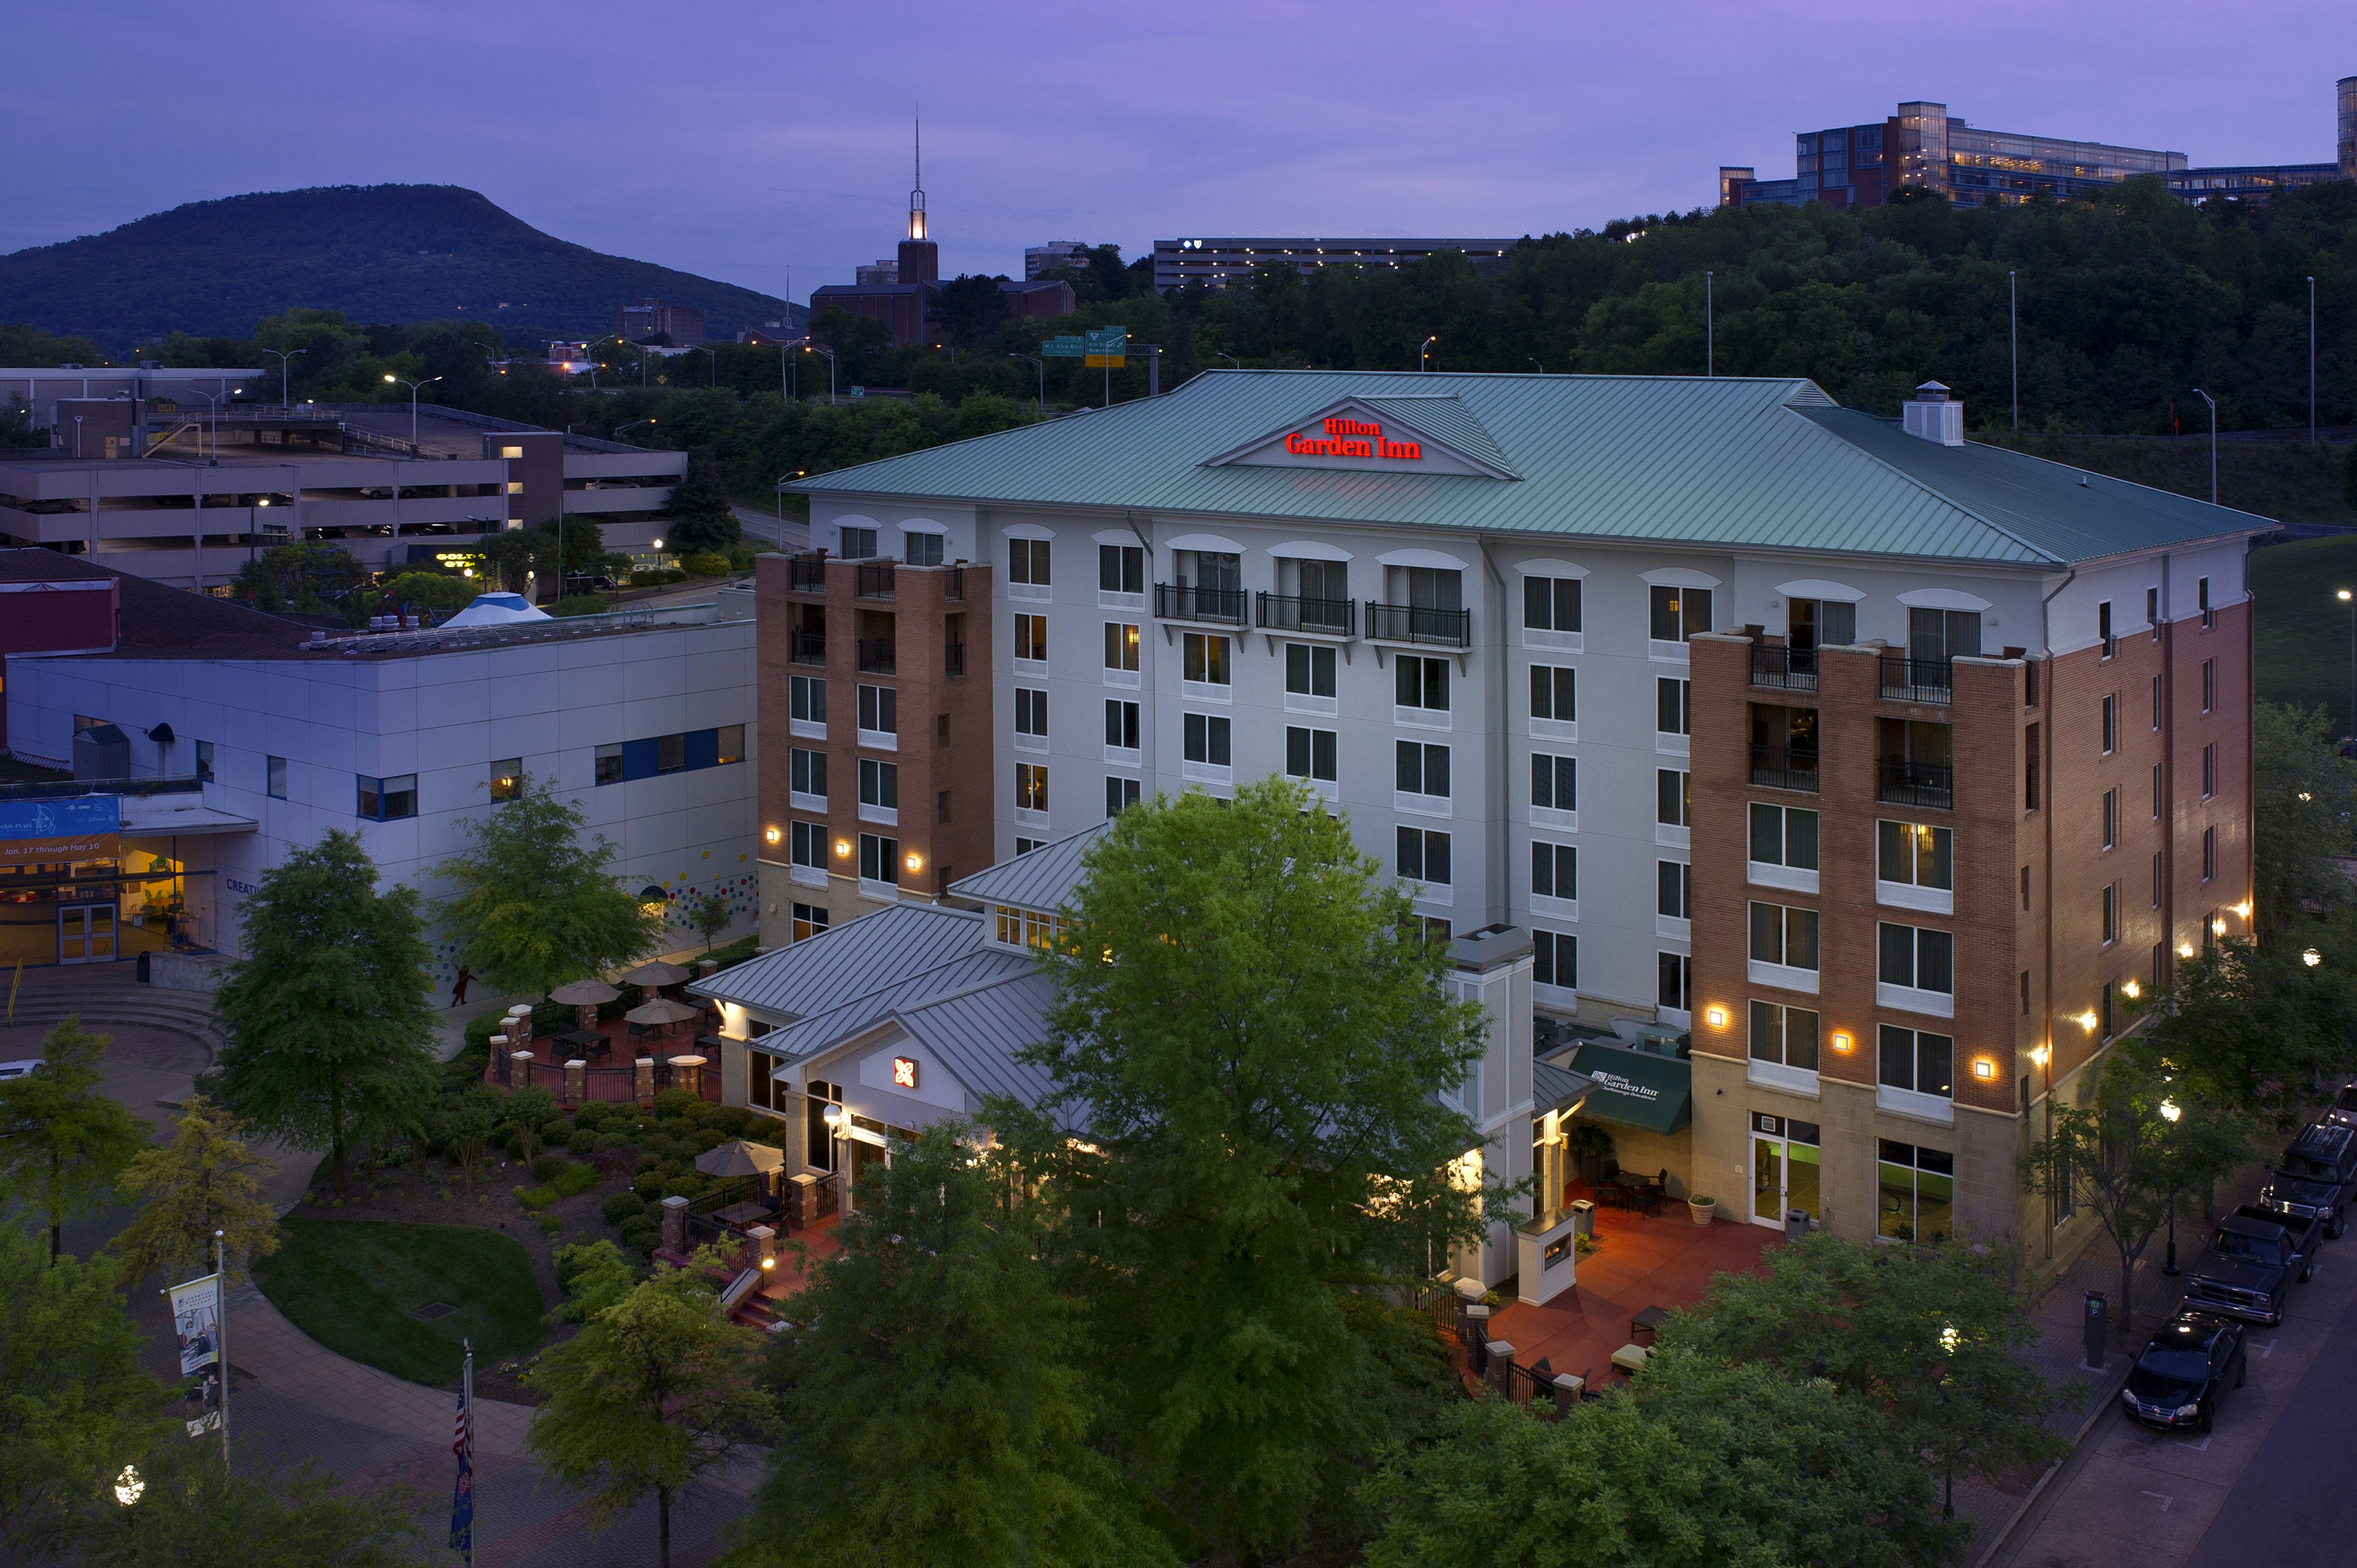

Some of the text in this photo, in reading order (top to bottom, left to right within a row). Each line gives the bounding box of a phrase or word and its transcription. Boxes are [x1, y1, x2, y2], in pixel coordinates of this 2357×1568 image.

[1324, 418, 1381, 435] Hilton
[1285, 433, 1421, 459] Garden Inn
[35, 845, 68, 854] through
[1607, 1074, 1630, 1083] Hilton
[1604, 1079, 1658, 1097] Garden Inn
[186, 1293, 215, 1305] DISCOVERY
[190, 1298, 211, 1307] MUSEUM
